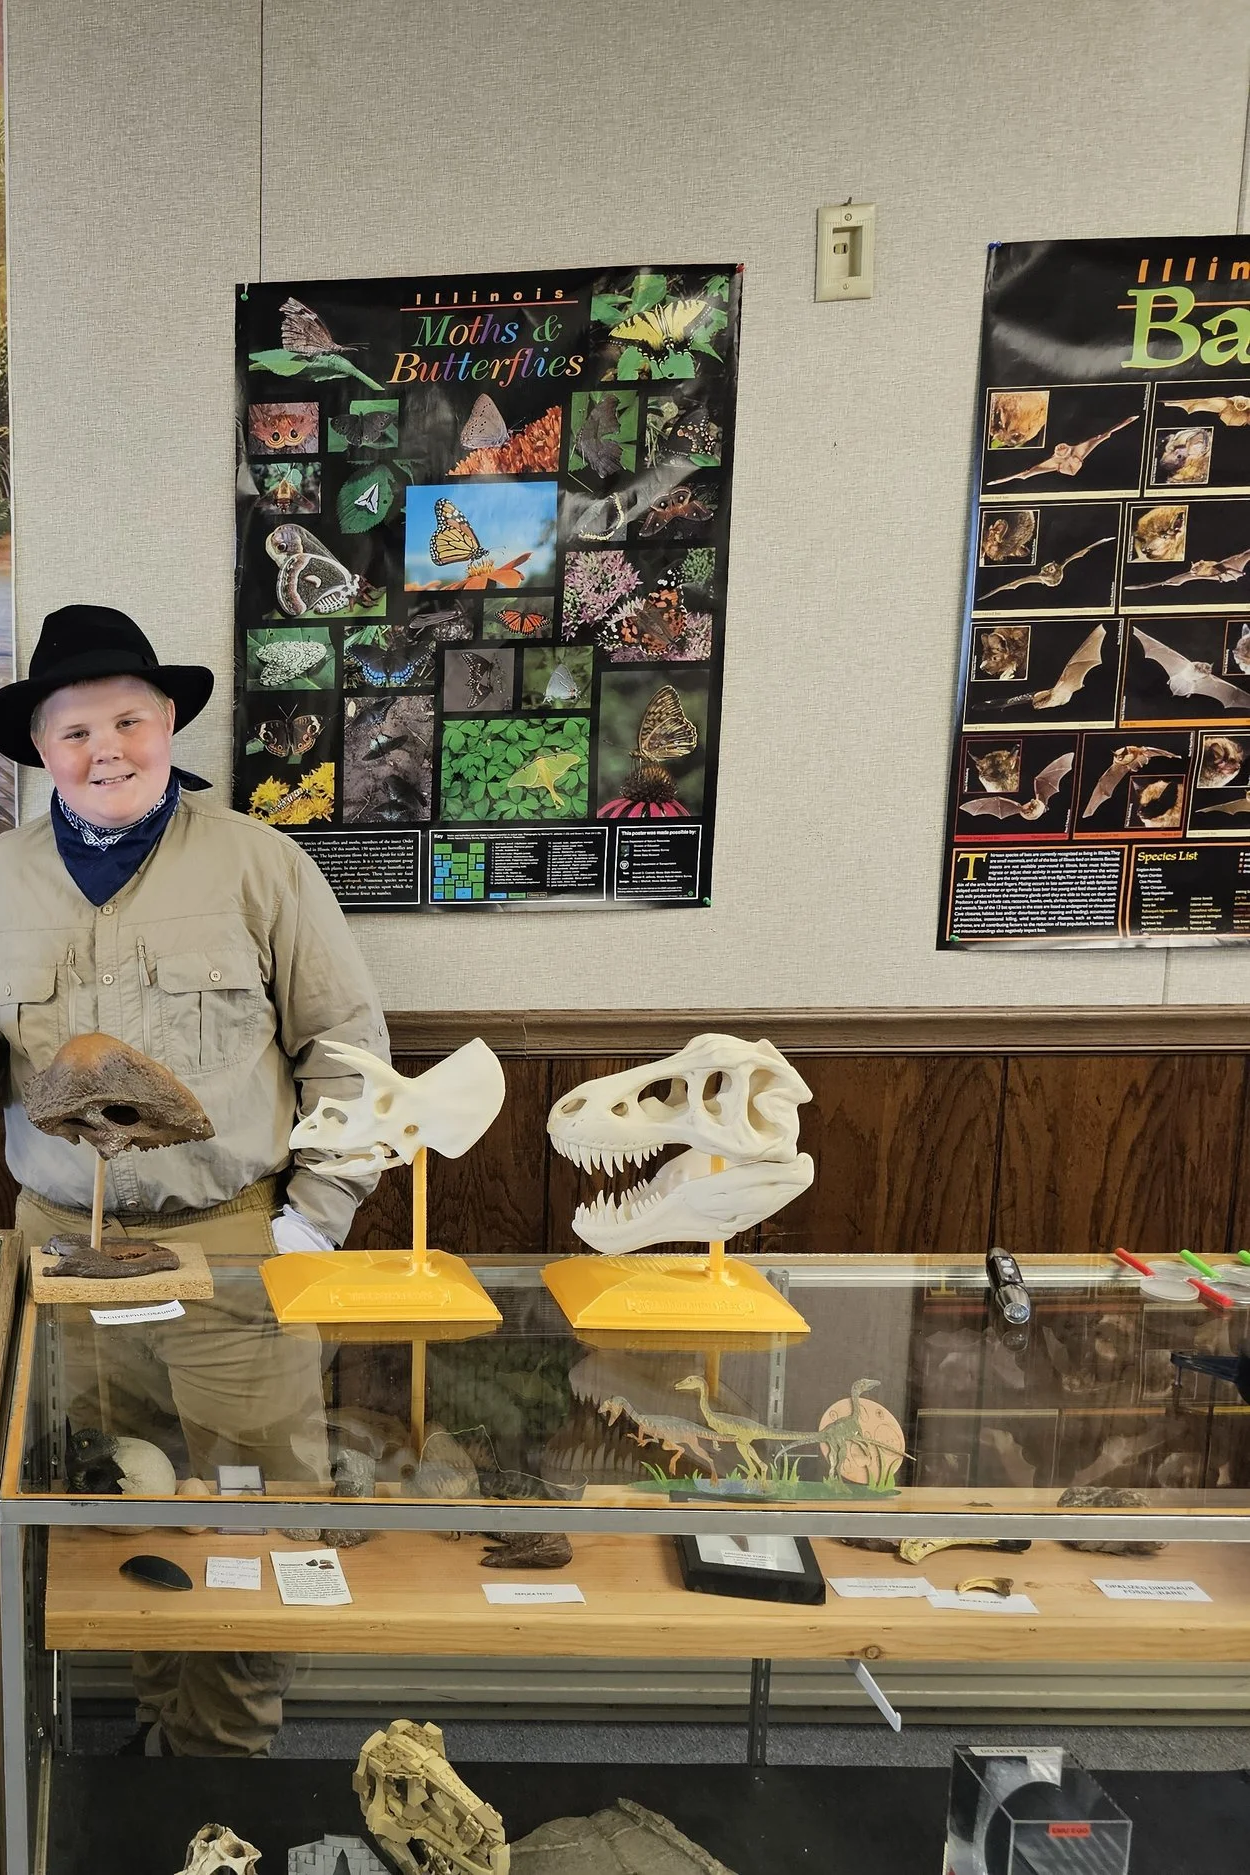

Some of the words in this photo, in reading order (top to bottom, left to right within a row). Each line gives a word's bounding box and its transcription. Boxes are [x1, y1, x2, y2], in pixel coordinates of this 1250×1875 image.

[1138, 256, 1250, 283] Illin
[416, 288, 564, 305] Illinois
[412, 312, 520, 347] Moths
[532, 314, 562, 342] &
[1121, 286, 1250, 369] Ba
[386, 346, 584, 388] Butterflies
[1138, 852, 1176, 864] Species
[1178, 851, 1198, 861] List
